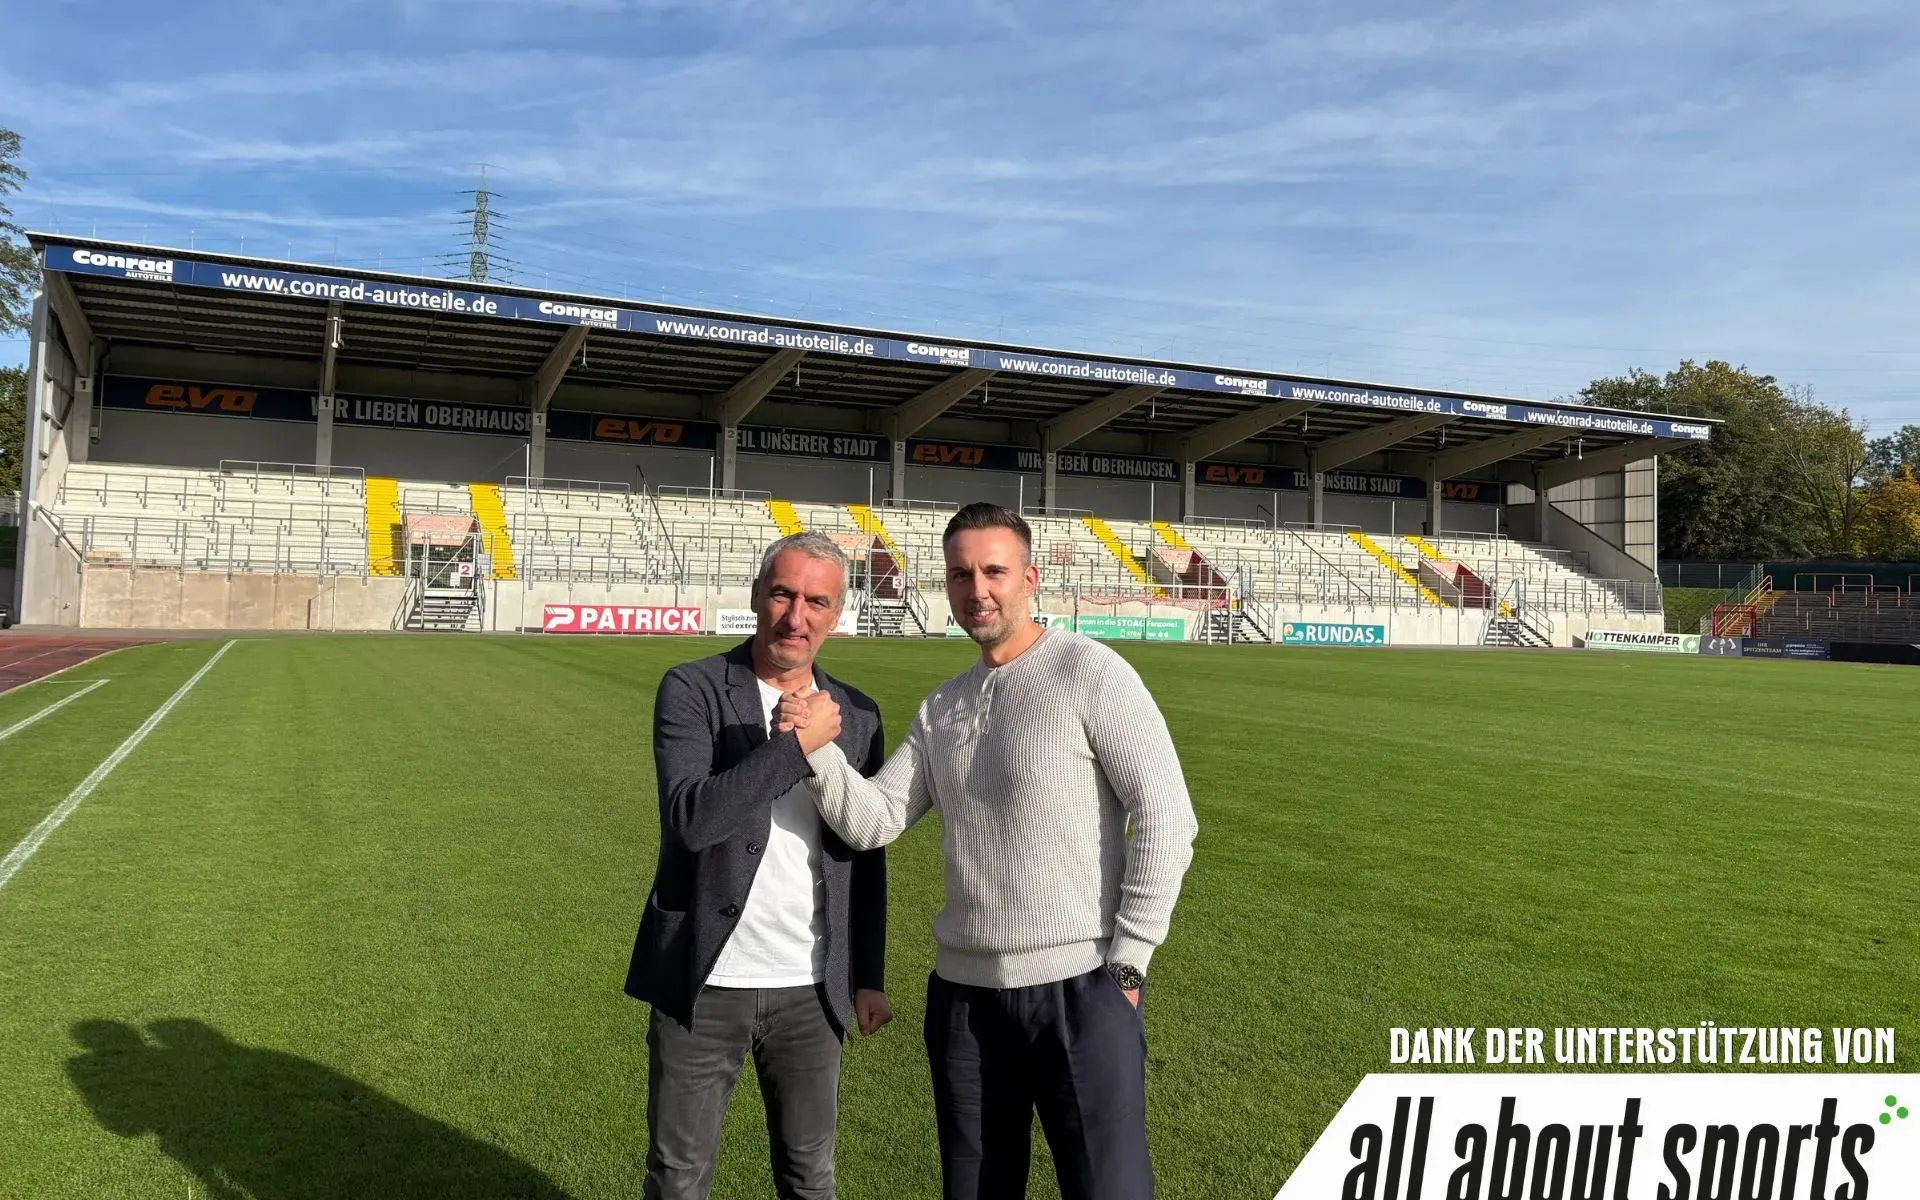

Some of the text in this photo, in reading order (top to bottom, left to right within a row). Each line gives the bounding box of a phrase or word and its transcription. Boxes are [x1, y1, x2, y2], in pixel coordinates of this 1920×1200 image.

[72, 250, 173, 273] Conrad
[125, 271, 173, 282] AUTOTEILE
[222, 272, 498, 315] www.conrad-autoteile.de
[538, 301, 618, 322] Conrad
[579, 319, 617, 329] AUTOTEILE
[656, 319, 875, 356] www.conrad-autoteile.de
[906, 343, 970, 359] Conrad
[1000, 357, 1177, 386] www.conrad-autoteile.de
[79, 380, 86, 390] 1
[1215, 375, 1267, 390] Conrad
[145, 384, 258, 412] evo
[323, 398, 329, 408] 1
[1292, 386, 1441, 412] www.conrad-autoteile.de
[355, 400, 419, 424] LIEBEN
[1463, 401, 1507, 415] Conrad
[536, 414, 542, 424] 1
[1528, 411, 1653, 434] www.conrad-autoteile.de
[594, 418, 683, 443] evo
[727, 430, 736, 438] 2
[1671, 423, 1709, 435] Conrad
[761, 431, 829, 454] UNSERER
[833, 437, 878, 457] STADT
[1018, 452, 1042, 468] WIR
[1048, 455, 1055, 463] 2
[1205, 466, 1266, 485] evo
[1370, 478, 1402, 494] STADT
[461, 565, 470, 575] 2
[894, 578, 903, 588] 3
[579, 607, 700, 631] PATRICK
[1306, 625, 1375, 643] RUNDAS
[1744, 627, 1749, 635] 7
